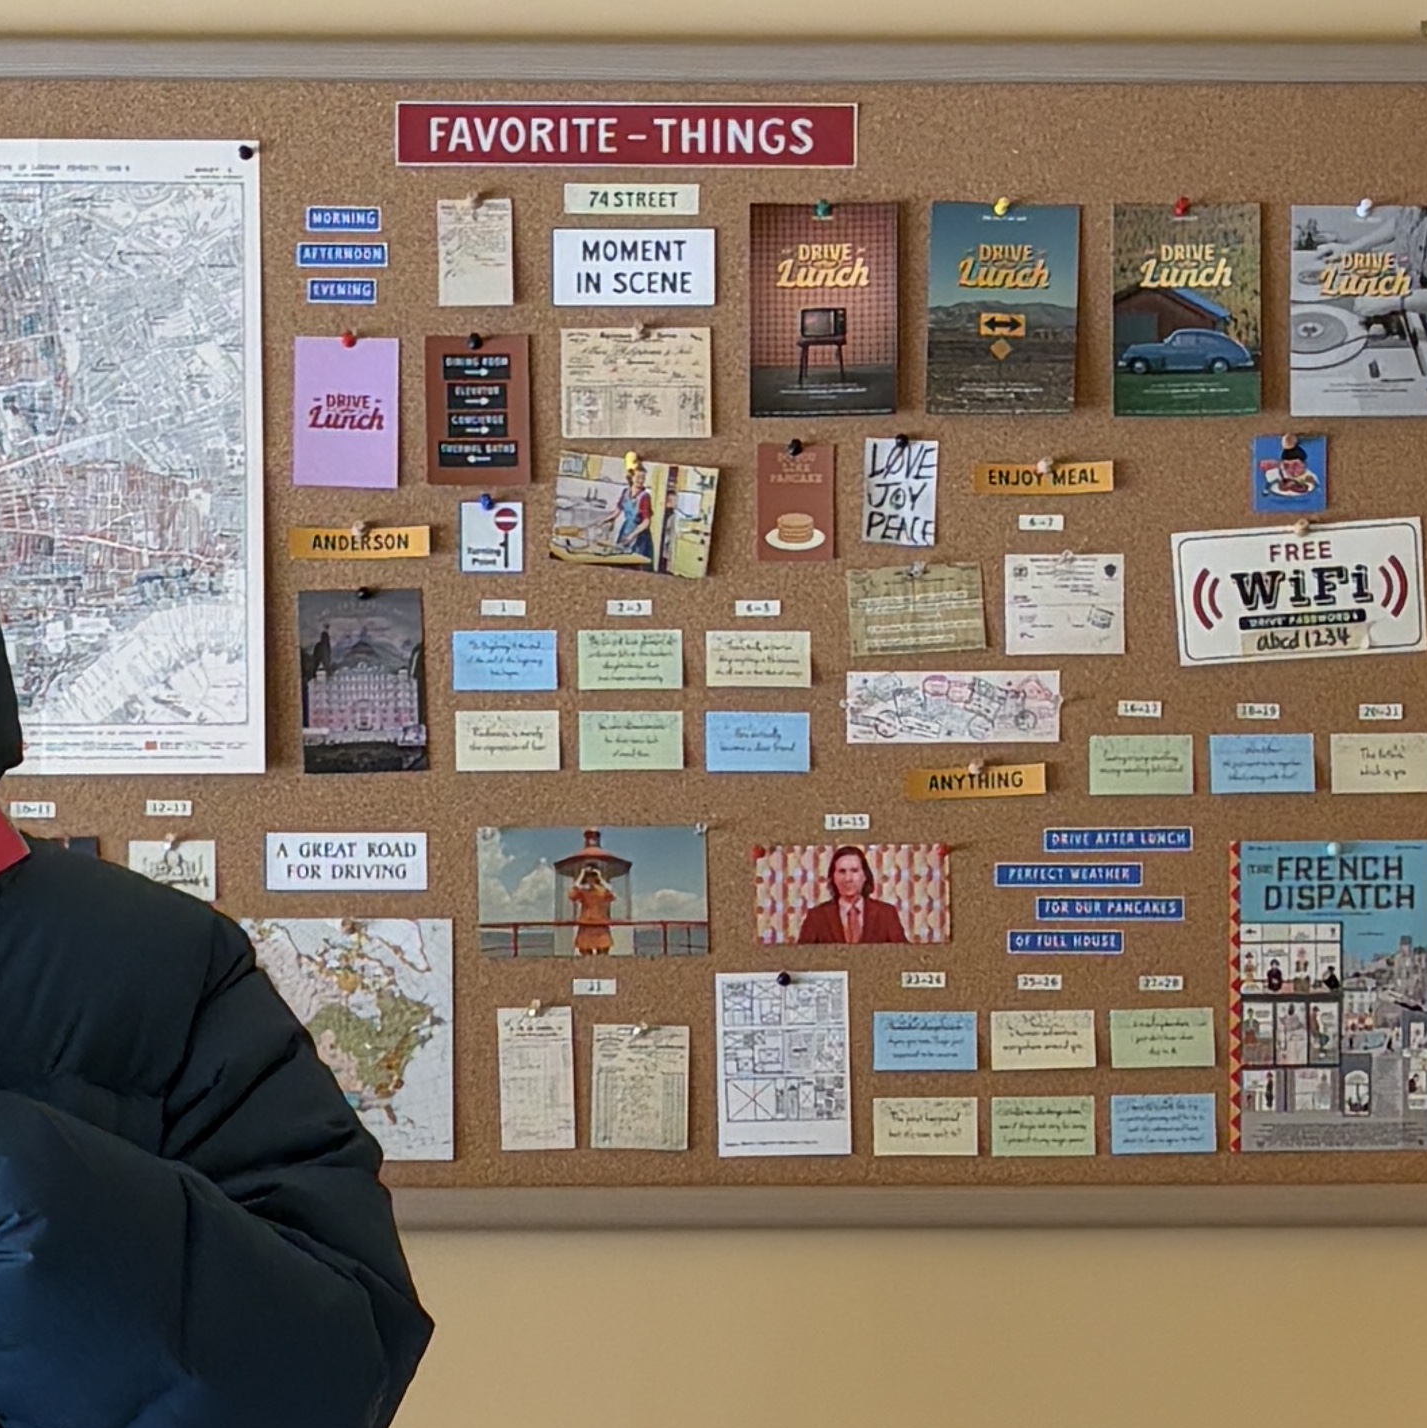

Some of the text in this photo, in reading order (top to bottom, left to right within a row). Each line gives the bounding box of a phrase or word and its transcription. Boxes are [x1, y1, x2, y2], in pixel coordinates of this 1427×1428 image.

[589, 191, 677, 208] 74 STREET
[311, 212, 376, 226] MORNING
[303, 248, 382, 262] AFTERNOON
[582, 240, 685, 262] MOMENT
[798, 243, 852, 261] DRIVE
[979, 244, 1033, 261] DRIVE
[1161, 244, 1214, 261] DRIVE
[1342, 253, 1395, 269] DRIVE
[576, 271, 692, 294] IN SCENE
[777, 258, 870, 289] Lunch
[958, 257, 1050, 290] Lunch
[1140, 258, 1232, 289] Lunch
[1320, 267, 1413, 297] Lunch
[313, 284, 371, 298] EVENING
[326, 394, 370, 409] DRIVE
[308, 406, 384, 431] Lunch
[988, 468, 1100, 487] ENJOY MEAL
[867, 511, 933, 546] PEACE
[312, 533, 410, 551] ANDERSON
[1269, 541, 1332, 562] FREE
[1231, 565, 1373, 610] WiFi
[929, 772, 1023, 791] ANYTHING
[1052, 832, 1186, 845] DRIVE AFTER LUNCH
[277, 842, 416, 858] A GREAT ROAD
[287, 864, 407, 879] FOR DRIVING
[1008, 868, 1130, 880] PERFECT WEATHER
[1278, 856, 1403, 881] FRENCH
[1265, 884, 1414, 910] DISPATCH
[1045, 902, 1176, 913] FOR OUR PANCAKES
[1074, 936, 1116, 947] HOUSE
